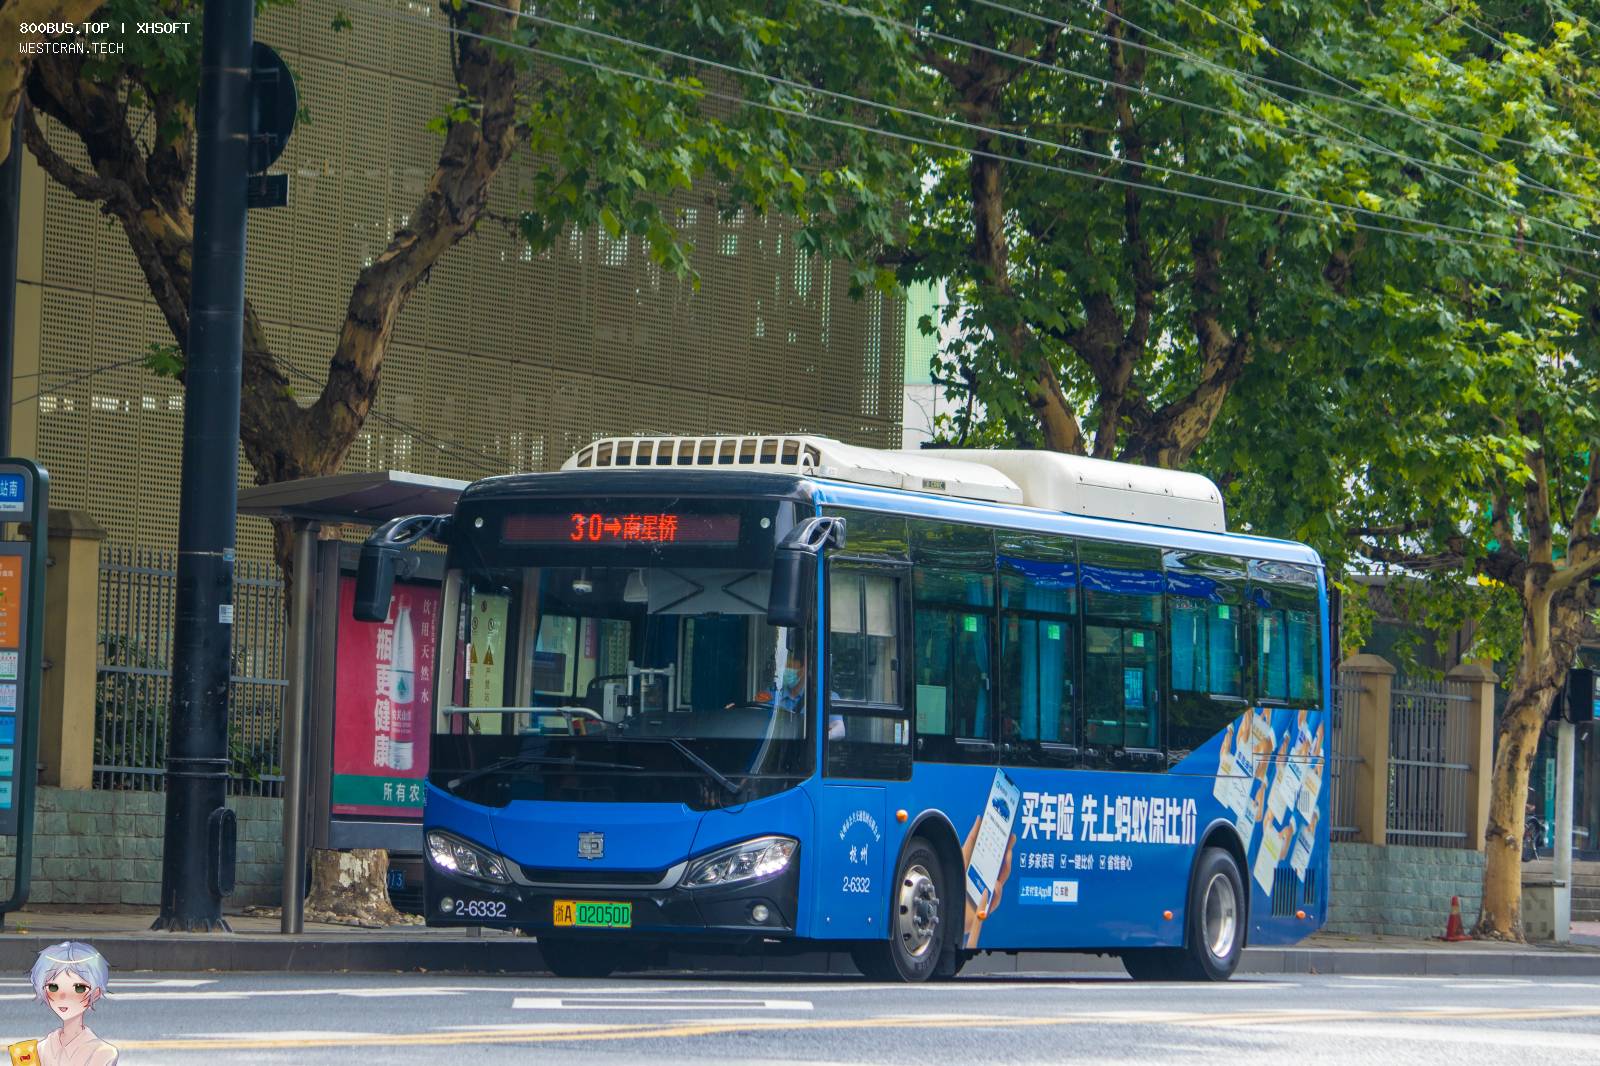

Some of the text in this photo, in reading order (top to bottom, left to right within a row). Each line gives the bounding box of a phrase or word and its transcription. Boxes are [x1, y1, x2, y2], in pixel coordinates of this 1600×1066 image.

[570, 513, 678, 542] 30 南星桥
[420, 599, 432, 704] 饮用天然水
[382, 782, 420, 804] 所有农
[1021, 792, 1198, 845] 买车险 先上蚂蚁保比价
[849, 843, 869, 865] 杭州
[1028, 853, 1055, 870] 多家保司
[1068, 854, 1095, 871] 一键比价
[842, 875, 870, 893] 2-6332
[455, 899, 507, 918] 2-6332
[579, 905, 630, 925] 02050D
